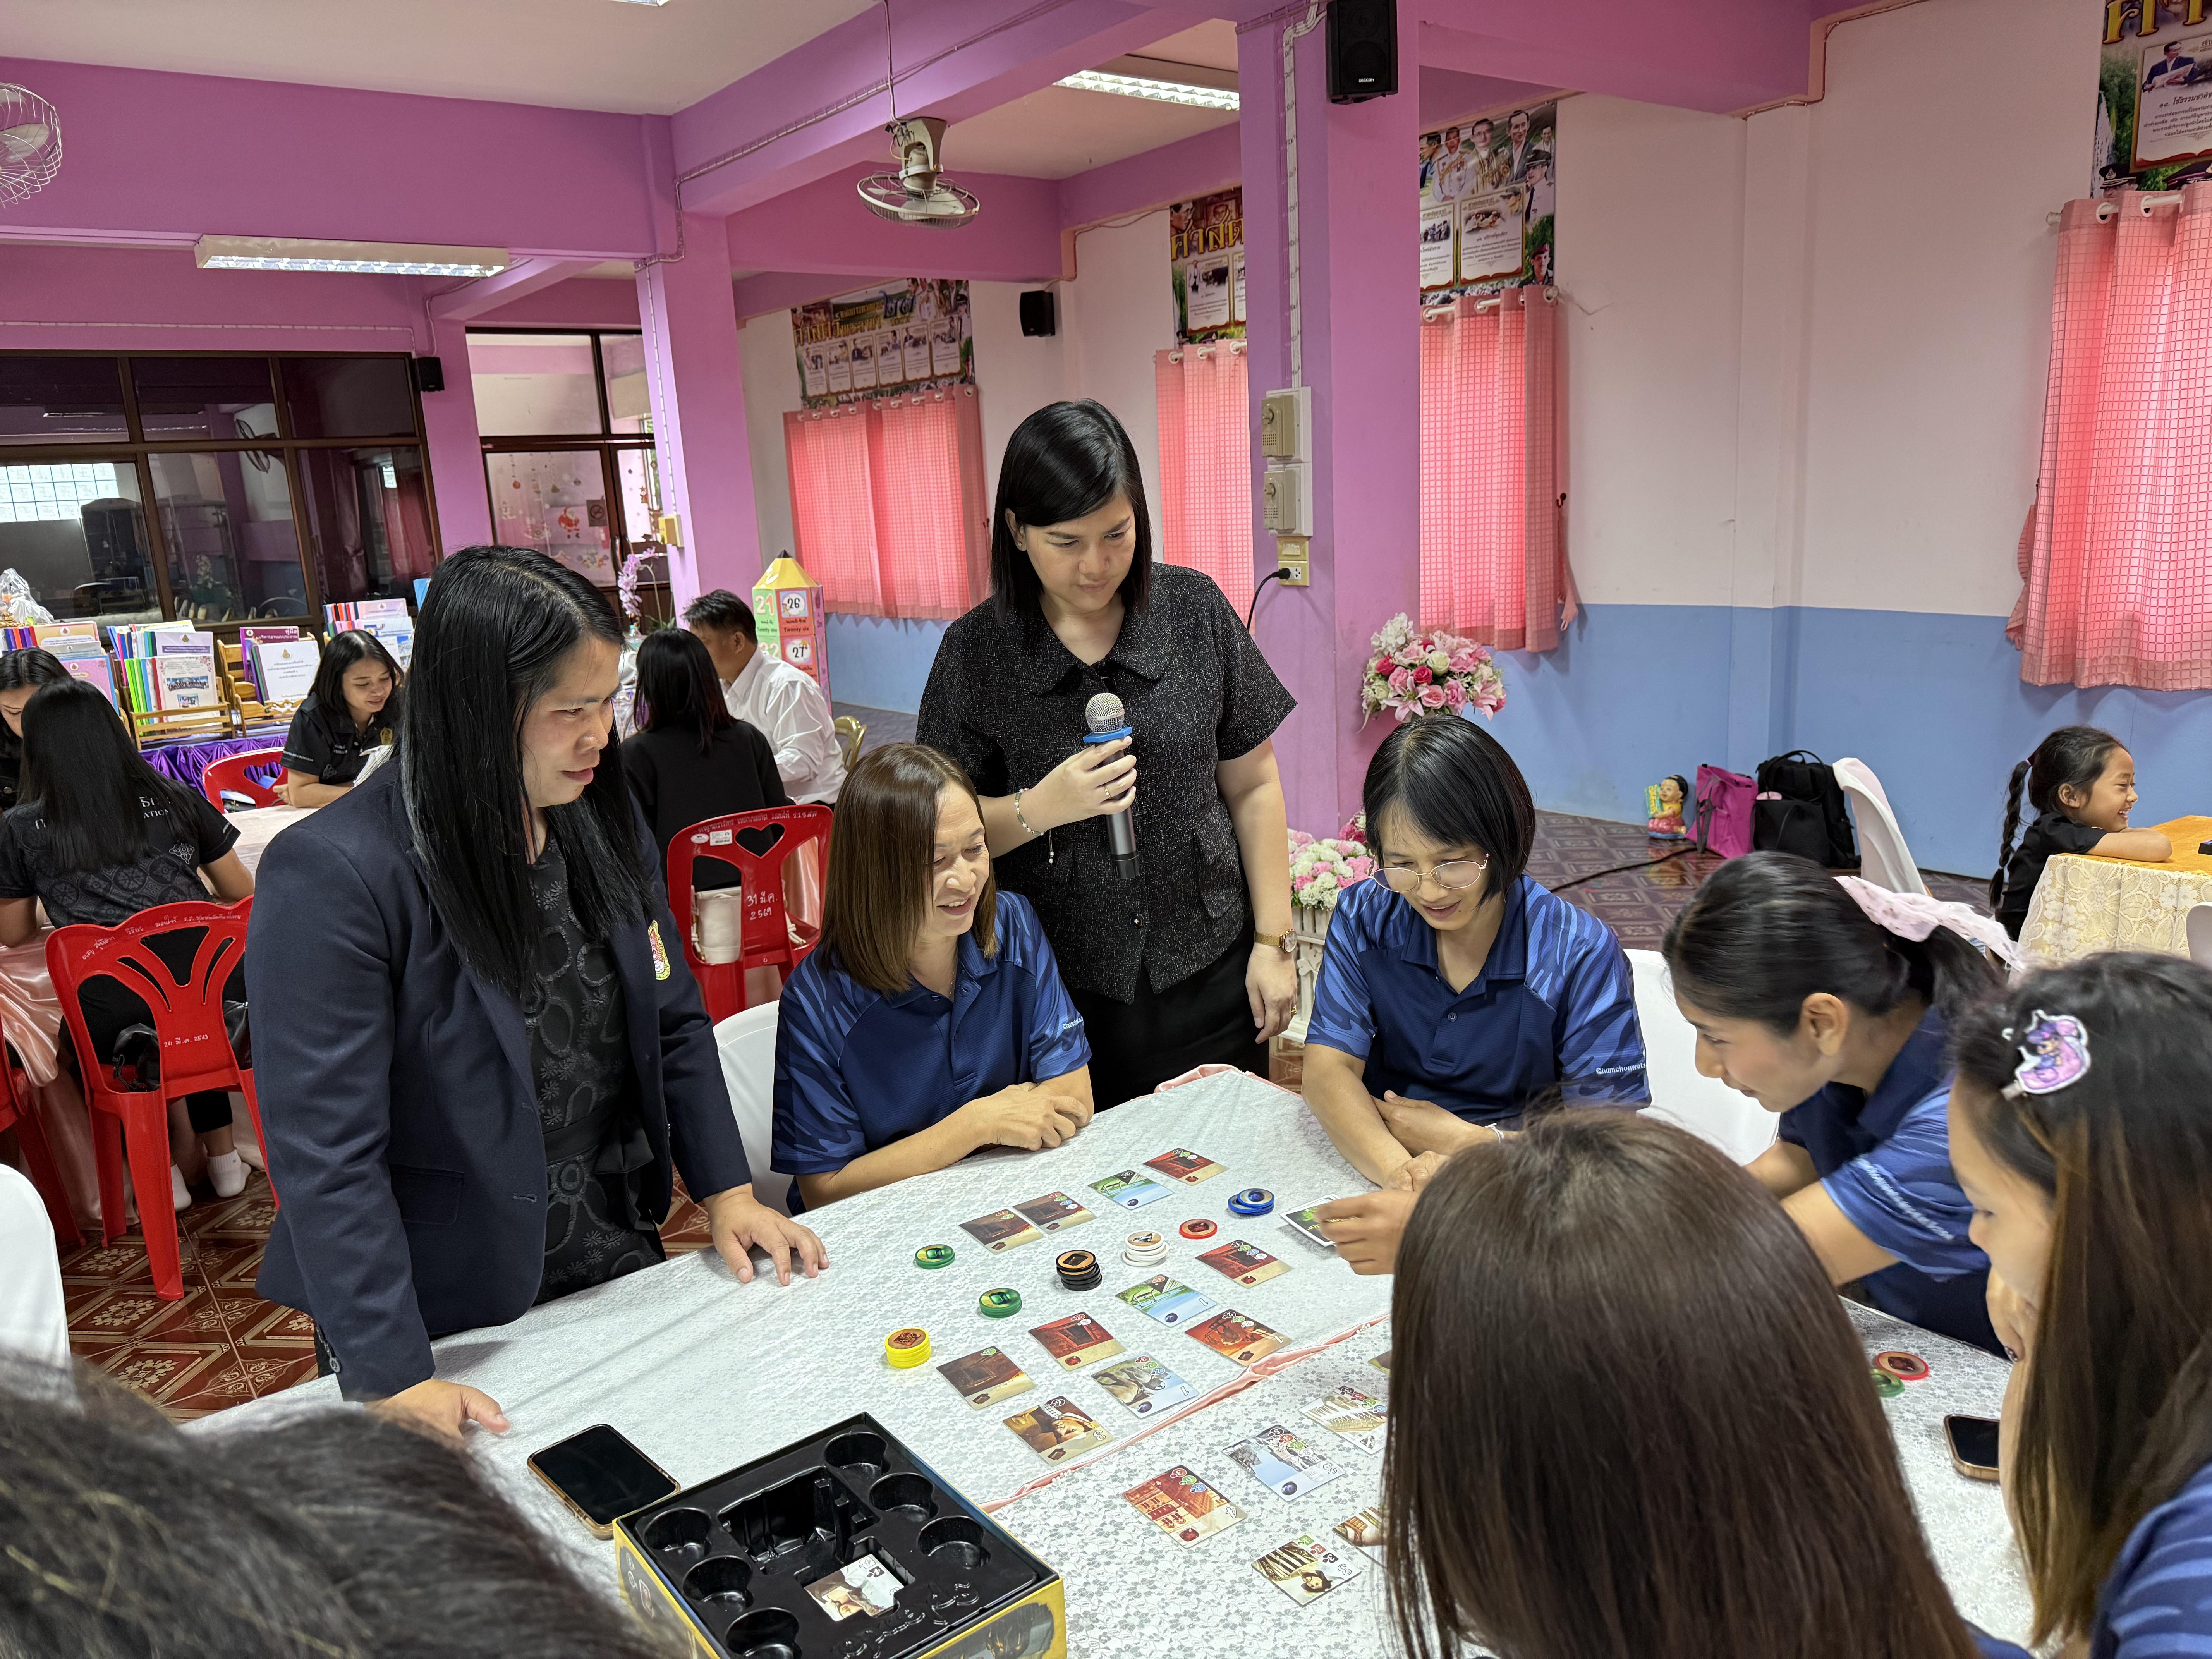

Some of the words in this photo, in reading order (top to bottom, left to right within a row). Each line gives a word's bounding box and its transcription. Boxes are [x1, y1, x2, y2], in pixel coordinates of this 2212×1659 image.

[756, 593, 774, 616] 21
[788, 598, 800, 609] 26
[747, 893, 757, 907] 31
[750, 907, 771, 920] 2569
[1199, 1298, 1208, 1306] 1
[1274, 1335, 1284, 1344] 1
[1180, 1386, 1190, 1396] 1
[1093, 1430, 1106, 1441] 3
[1322, 1463, 1337, 1475] 3
[1226, 1506, 1237, 1519] 4
[1337, 1563, 1352, 1576] 3
